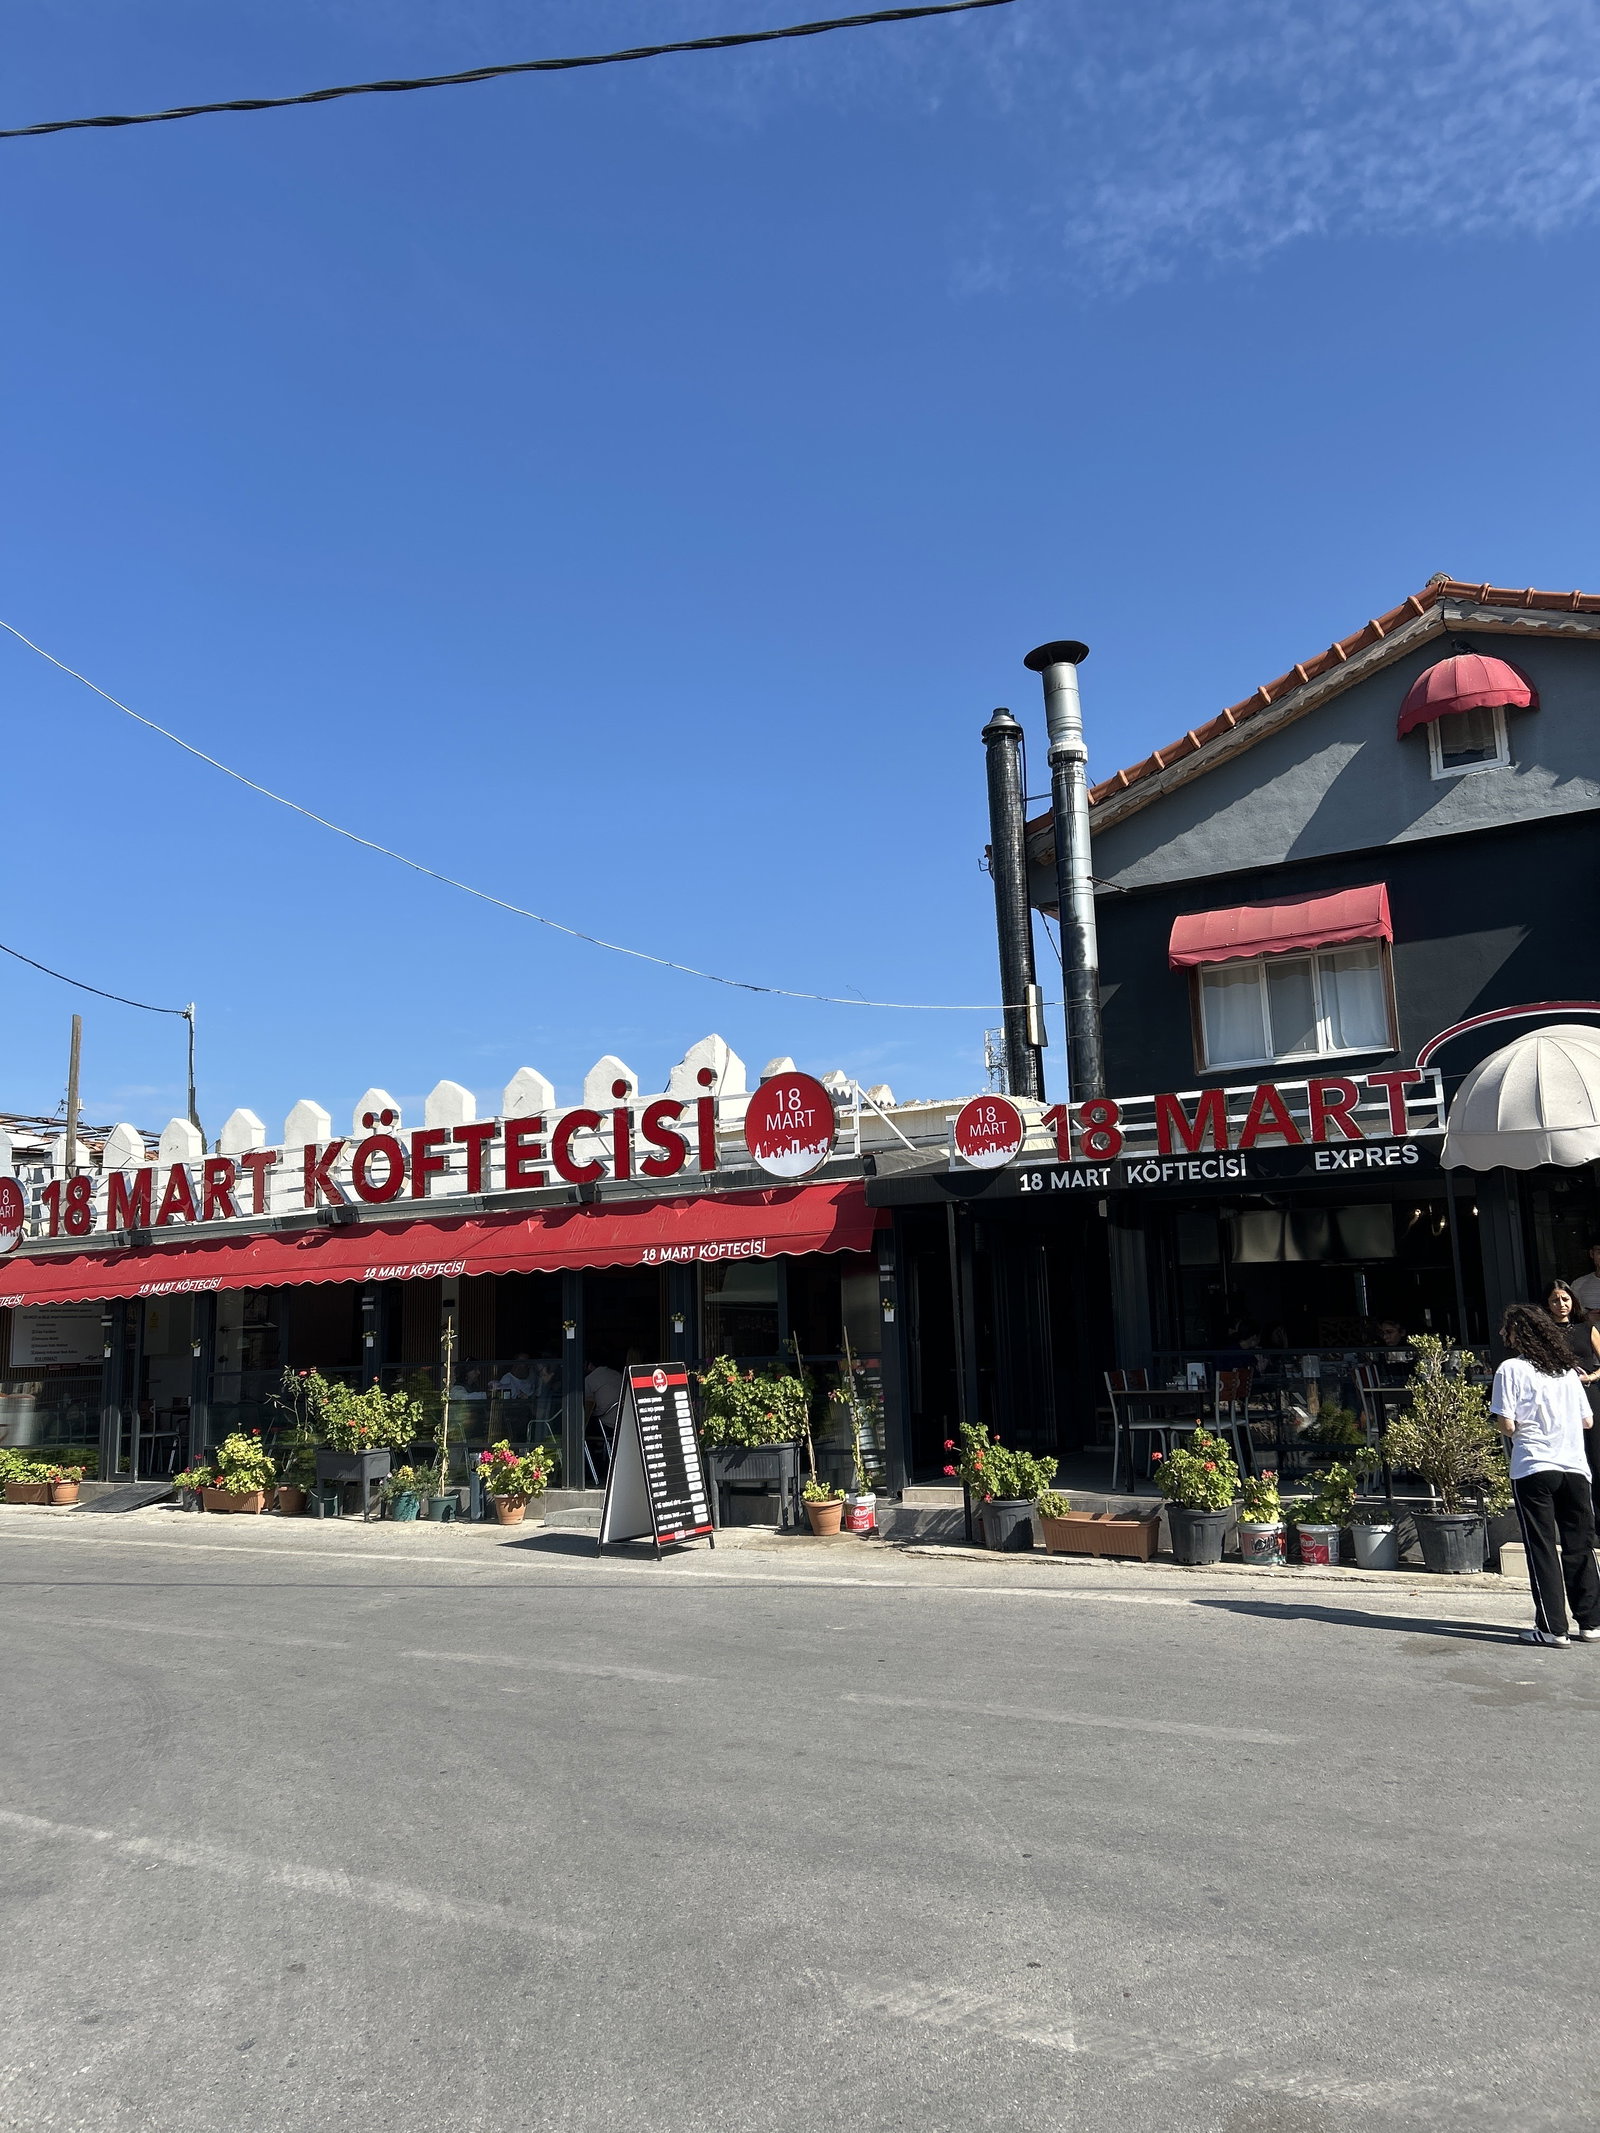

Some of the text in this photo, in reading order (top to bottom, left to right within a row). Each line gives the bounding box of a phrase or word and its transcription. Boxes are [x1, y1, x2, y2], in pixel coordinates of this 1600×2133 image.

[775, 1088, 802, 1112] 18
[766, 1109, 816, 1131] MART
[976, 1106, 997, 1123] 18
[1040, 1069, 1425, 1162] 18 MART
[969, 1121, 1008, 1137] MART
[40, 1067, 717, 1237] 18 MART KÖFTECİSİ
[1019, 1144, 1420, 1192] 18 MART KÖFTECİSİ EXPRES
[1, 1188, 11, 1206] 8
[0, 1204, 17, 1218] ART
[641, 1238, 767, 1261] 18 MART KÖFTECİSİ
[363, 1260, 467, 1278] 18 MART KÖFTECİSİ
[138, 1284, 150, 1294] 18
[149, 1281, 176, 1294] MART
